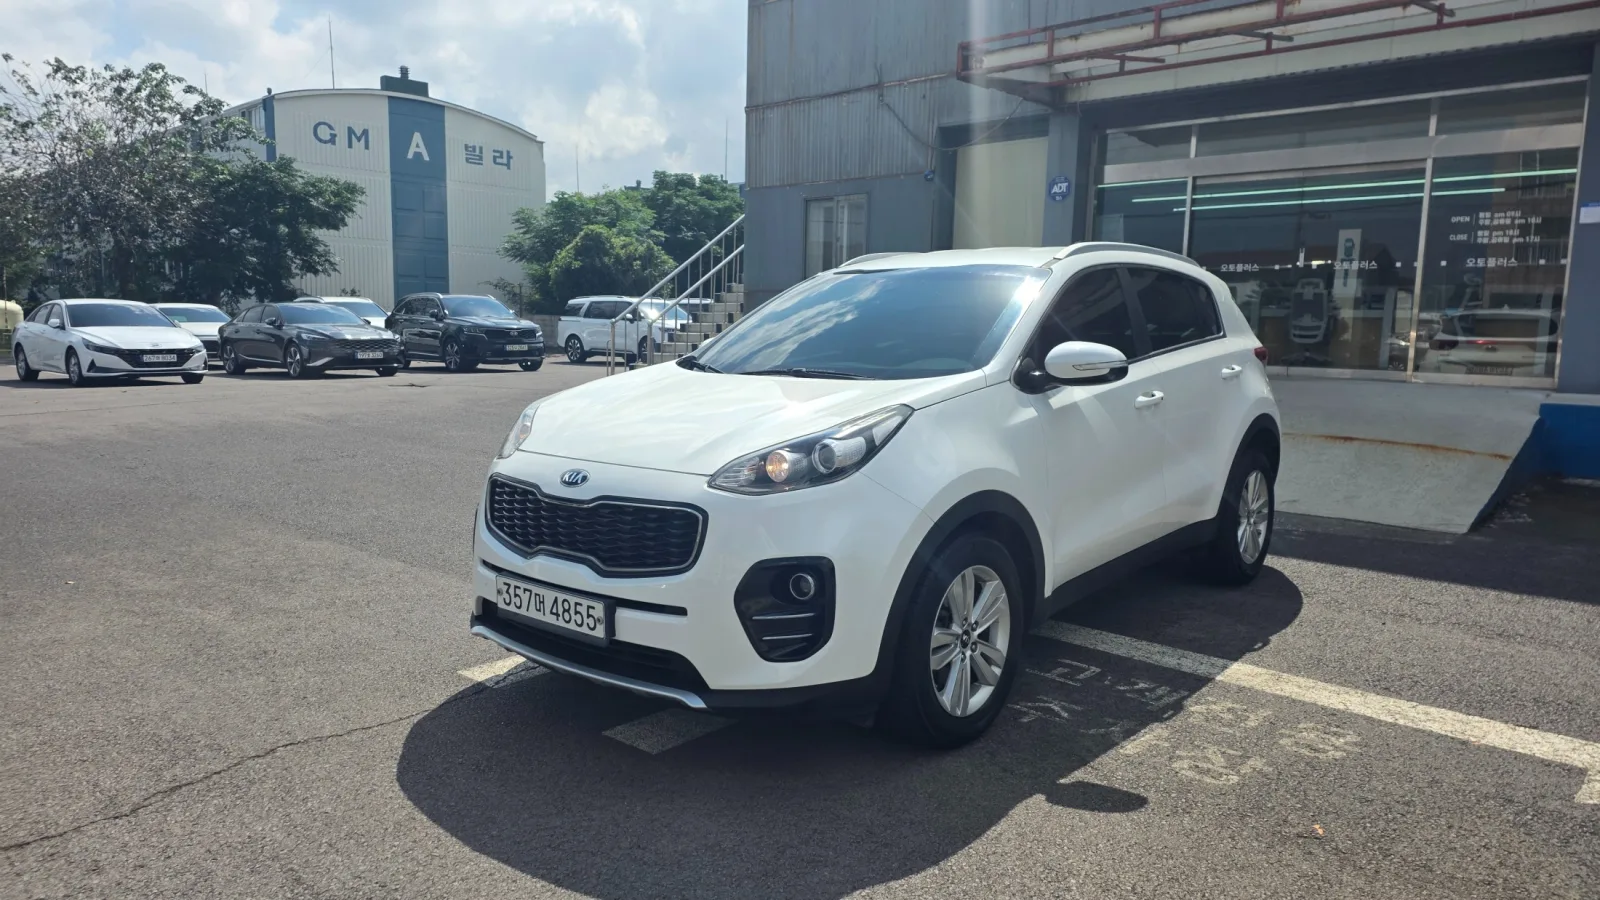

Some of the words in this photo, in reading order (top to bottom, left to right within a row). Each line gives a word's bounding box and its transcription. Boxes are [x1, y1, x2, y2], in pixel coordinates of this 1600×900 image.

[406, 131, 430, 161] A
[464, 143, 514, 170] 빌라
[1051, 182, 1069, 194] ADT
[1451, 215, 1471, 224] OPEN
[1449, 233, 1469, 241] CLOSE
[1220, 262, 1260, 272] 오토플러스
[1333, 260, 1378, 270] 오토플러스
[1465, 257, 1518, 268] 오토플러스
